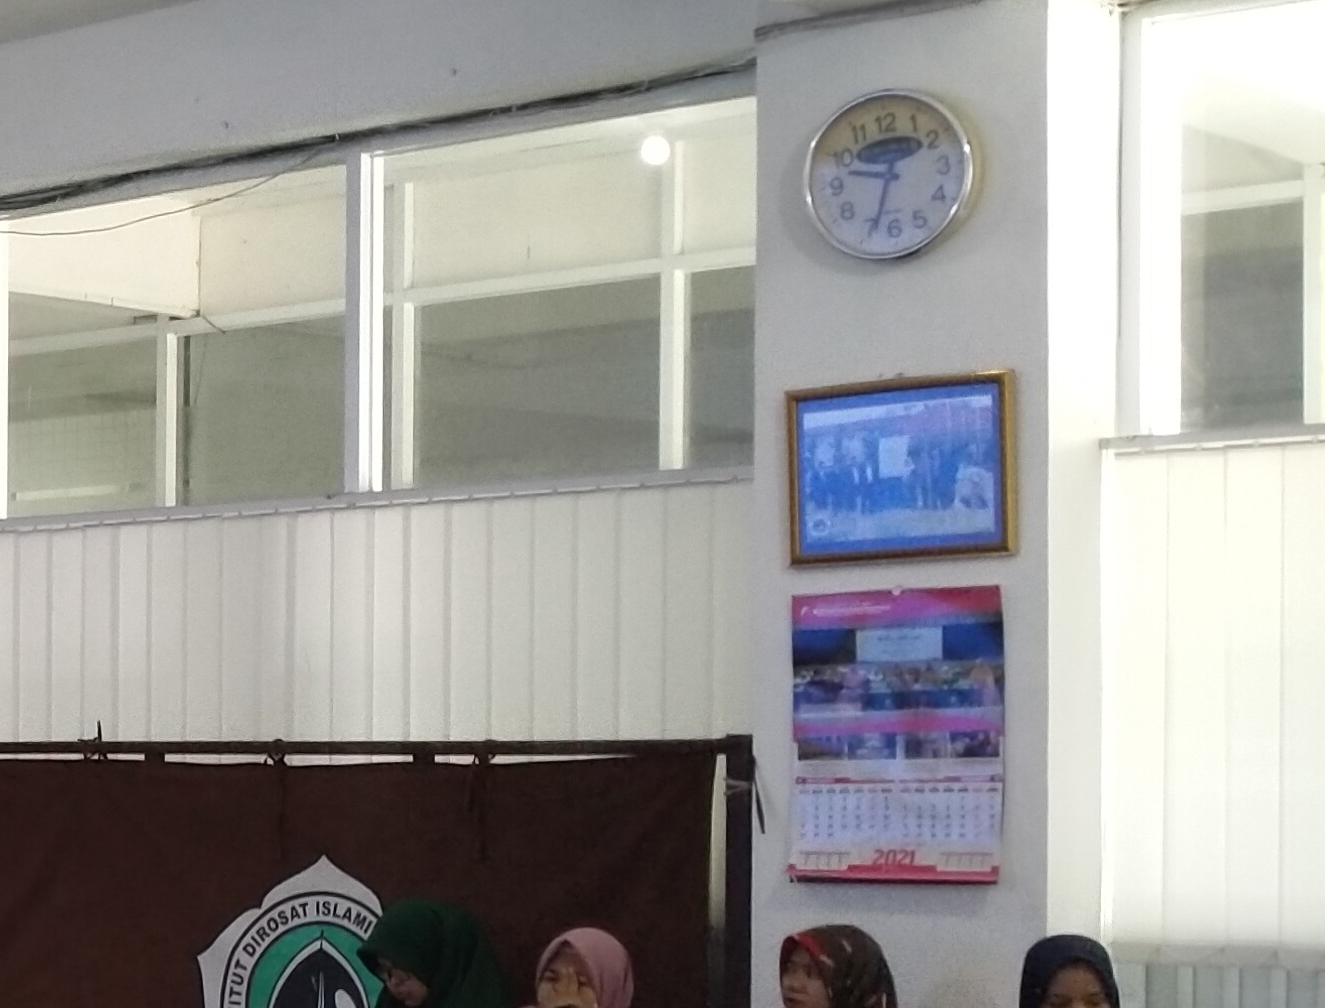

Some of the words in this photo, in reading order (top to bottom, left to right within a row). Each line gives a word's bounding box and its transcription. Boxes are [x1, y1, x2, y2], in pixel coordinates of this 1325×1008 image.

[874, 112, 898, 133] 12
[909, 113, 919, 132] 1
[850, 123, 867, 145] 11
[925, 130, 940, 150] 2
[828, 148, 855, 169] 10
[936, 155, 951, 175] 3
[829, 177, 844, 196] 9
[931, 184, 947, 202] 4
[840, 202, 855, 221] 8
[912, 210, 928, 229] 5
[865, 218, 879, 238] 7
[887, 218, 902, 238] 6
[873, 848, 917, 866] 2021
[243, 902, 310, 958] DIROSAT
